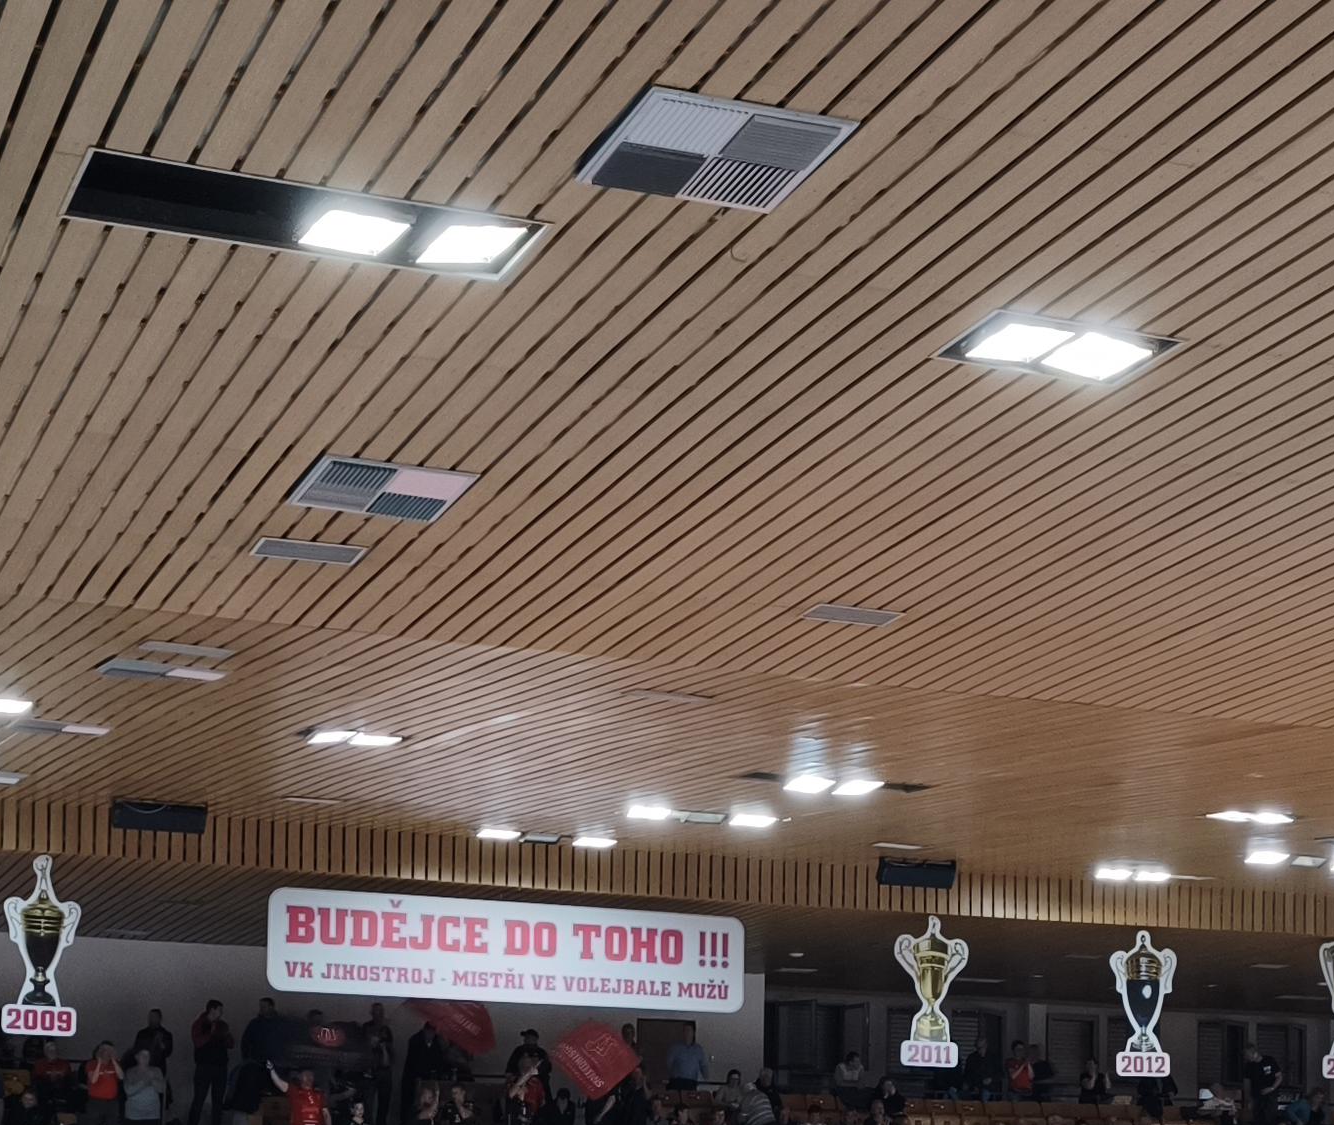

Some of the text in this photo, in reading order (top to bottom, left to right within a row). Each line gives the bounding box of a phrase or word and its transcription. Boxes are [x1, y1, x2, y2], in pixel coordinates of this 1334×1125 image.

[285, 899, 730, 969] BUDĚJCE DO TOHO !!!
[284, 961, 314, 978] VK
[320, 963, 436, 985] JIHOSTROJ
[452, 967, 525, 990] MISTŘI
[533, 974, 557, 992] VE
[564, 976, 671, 997] VOLEJBALE
[677, 979, 729, 1000] MUŽŮ
[6, 1009, 72, 1031] 2009
[908, 1045, 951, 1064] 2011
[1121, 1056, 1165, 1073] 2012
